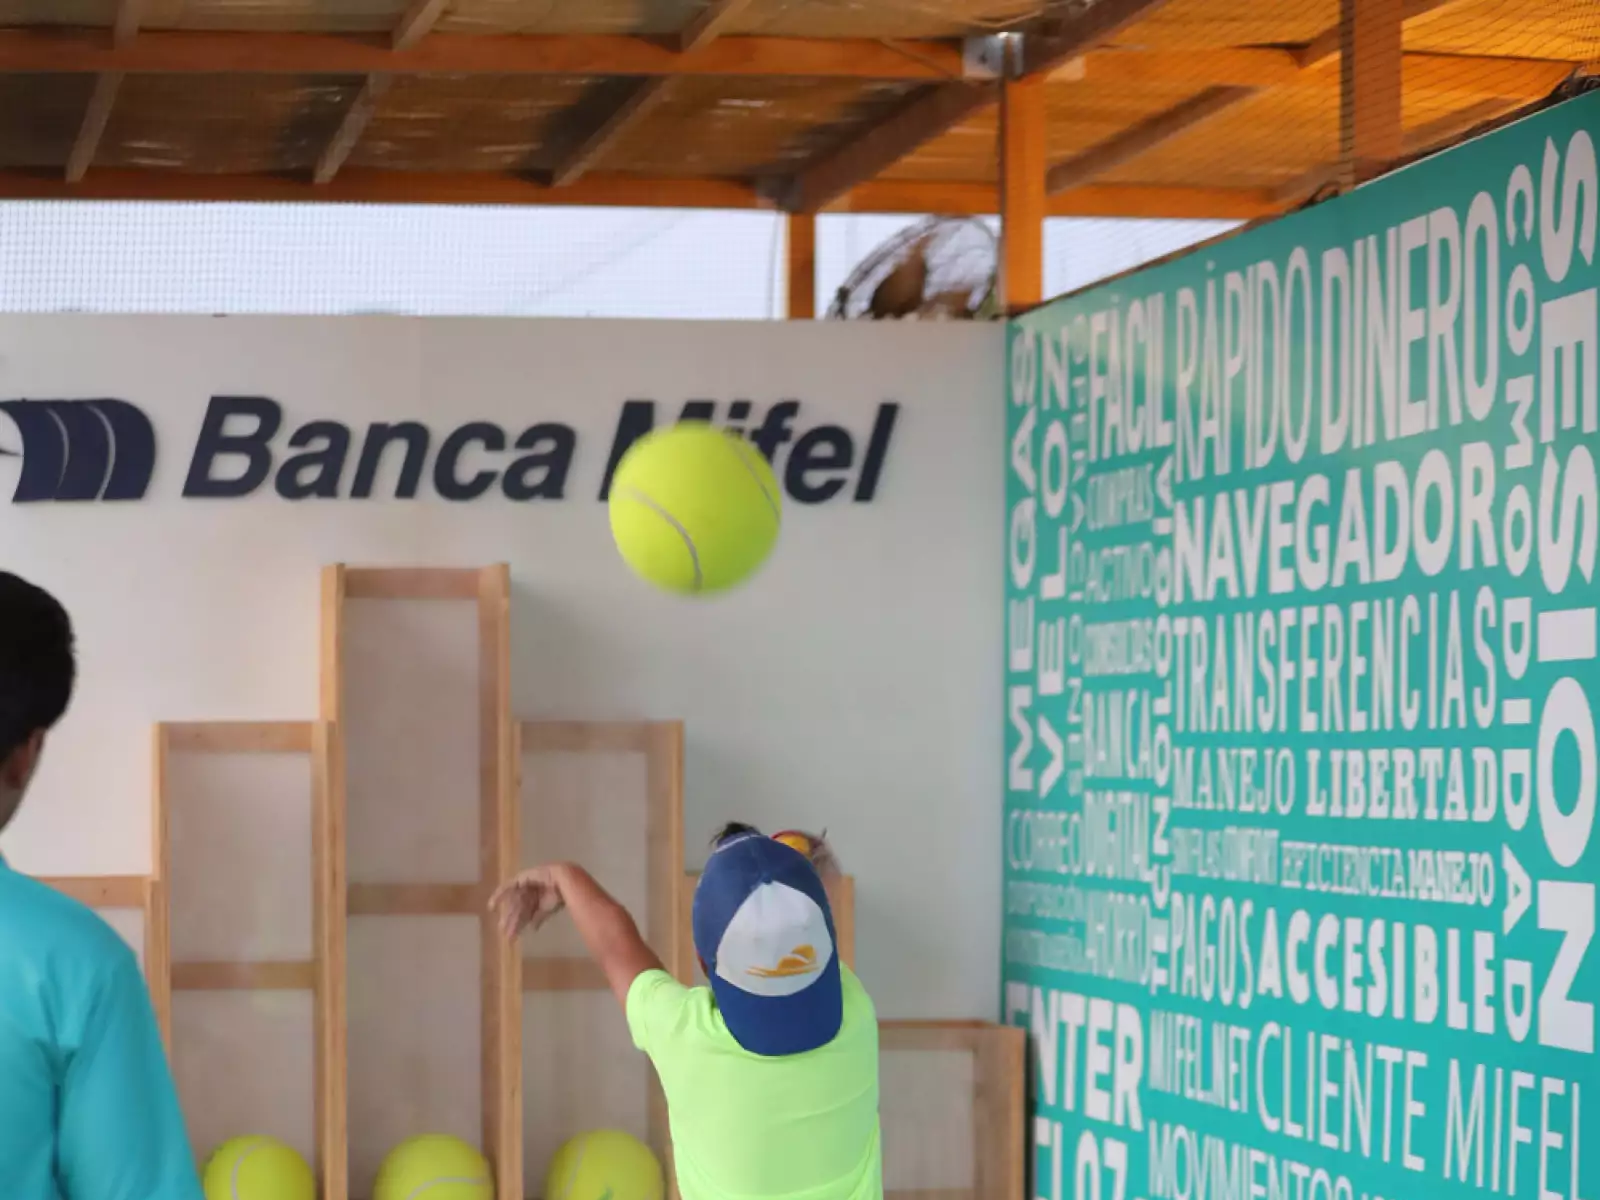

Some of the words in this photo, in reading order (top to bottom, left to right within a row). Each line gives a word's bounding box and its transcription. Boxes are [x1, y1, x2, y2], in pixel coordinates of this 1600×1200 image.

[1320, 191, 1498, 455] DINERO
[181, 395, 577, 502] Banca
[1174, 441, 1498, 605] NAVEGADOR
[1009, 327, 1037, 791] MEGAS
[1038, 326, 1070, 799] VELOZ
[1503, 165, 1534, 1042] COMODIDAD
[1538, 128, 1598, 1053] SESION
[1173, 586, 1498, 733] TRANSFERENCIAS
[1173, 748, 1295, 815] MANEJO
[1305, 748, 1498, 823] LIBERTAD
[1280, 841, 1406, 898] EFICIENCIA
[1409, 849, 1494, 907] MANEJO
[1170, 892, 1252, 1008] PAGOS
[1257, 907, 1496, 1036] ACCESIBLE
[1256, 1021, 1426, 1171] CLIENTE
